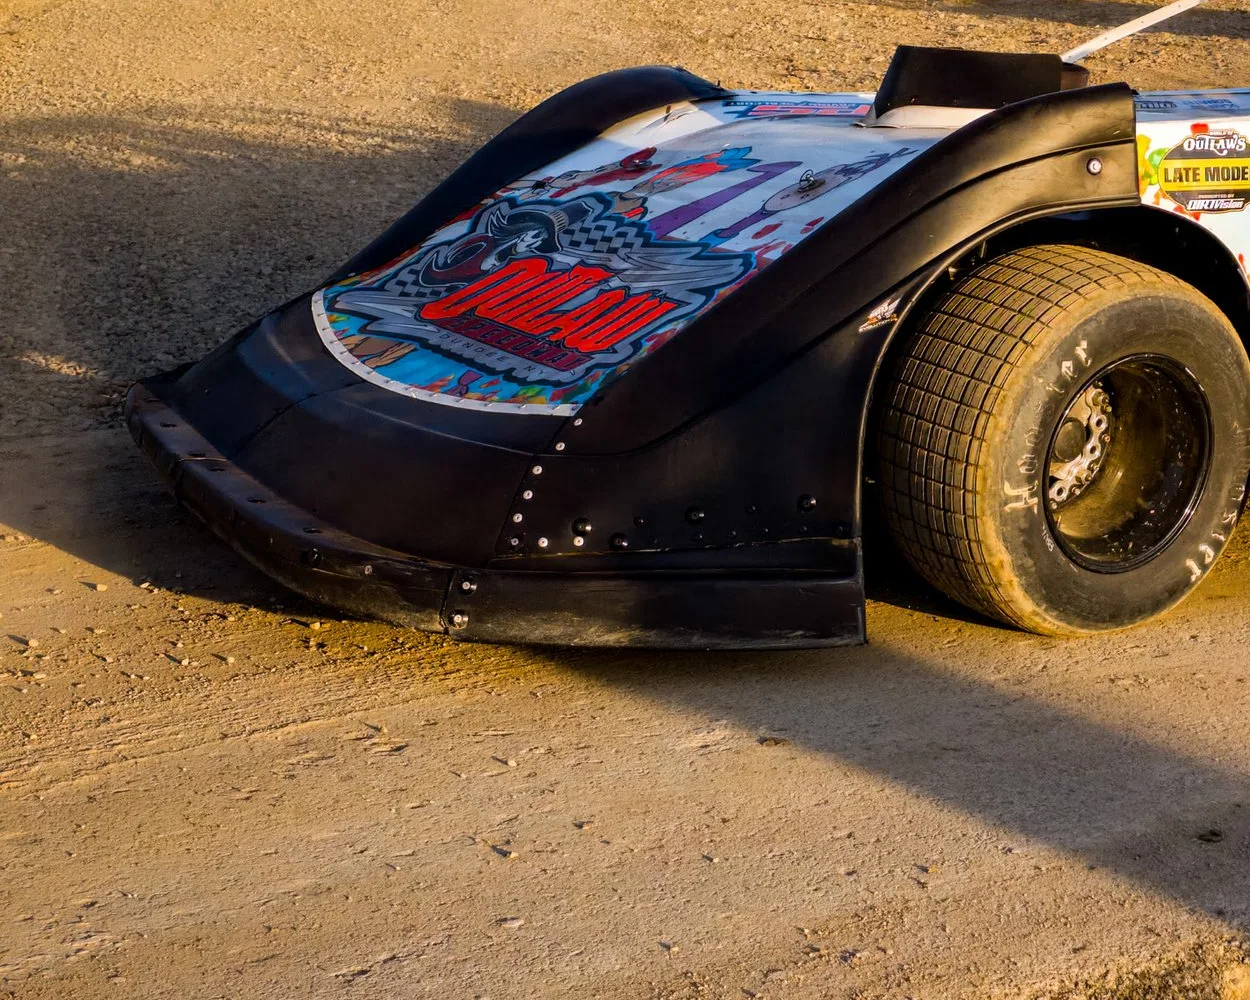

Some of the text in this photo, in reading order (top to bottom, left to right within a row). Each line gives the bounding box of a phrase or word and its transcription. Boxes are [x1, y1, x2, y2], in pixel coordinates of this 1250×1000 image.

[1164, 168, 1201, 183] LATE
[420, 258, 679, 353] OUTLAW
[439, 332, 512, 362] DUNDEE
